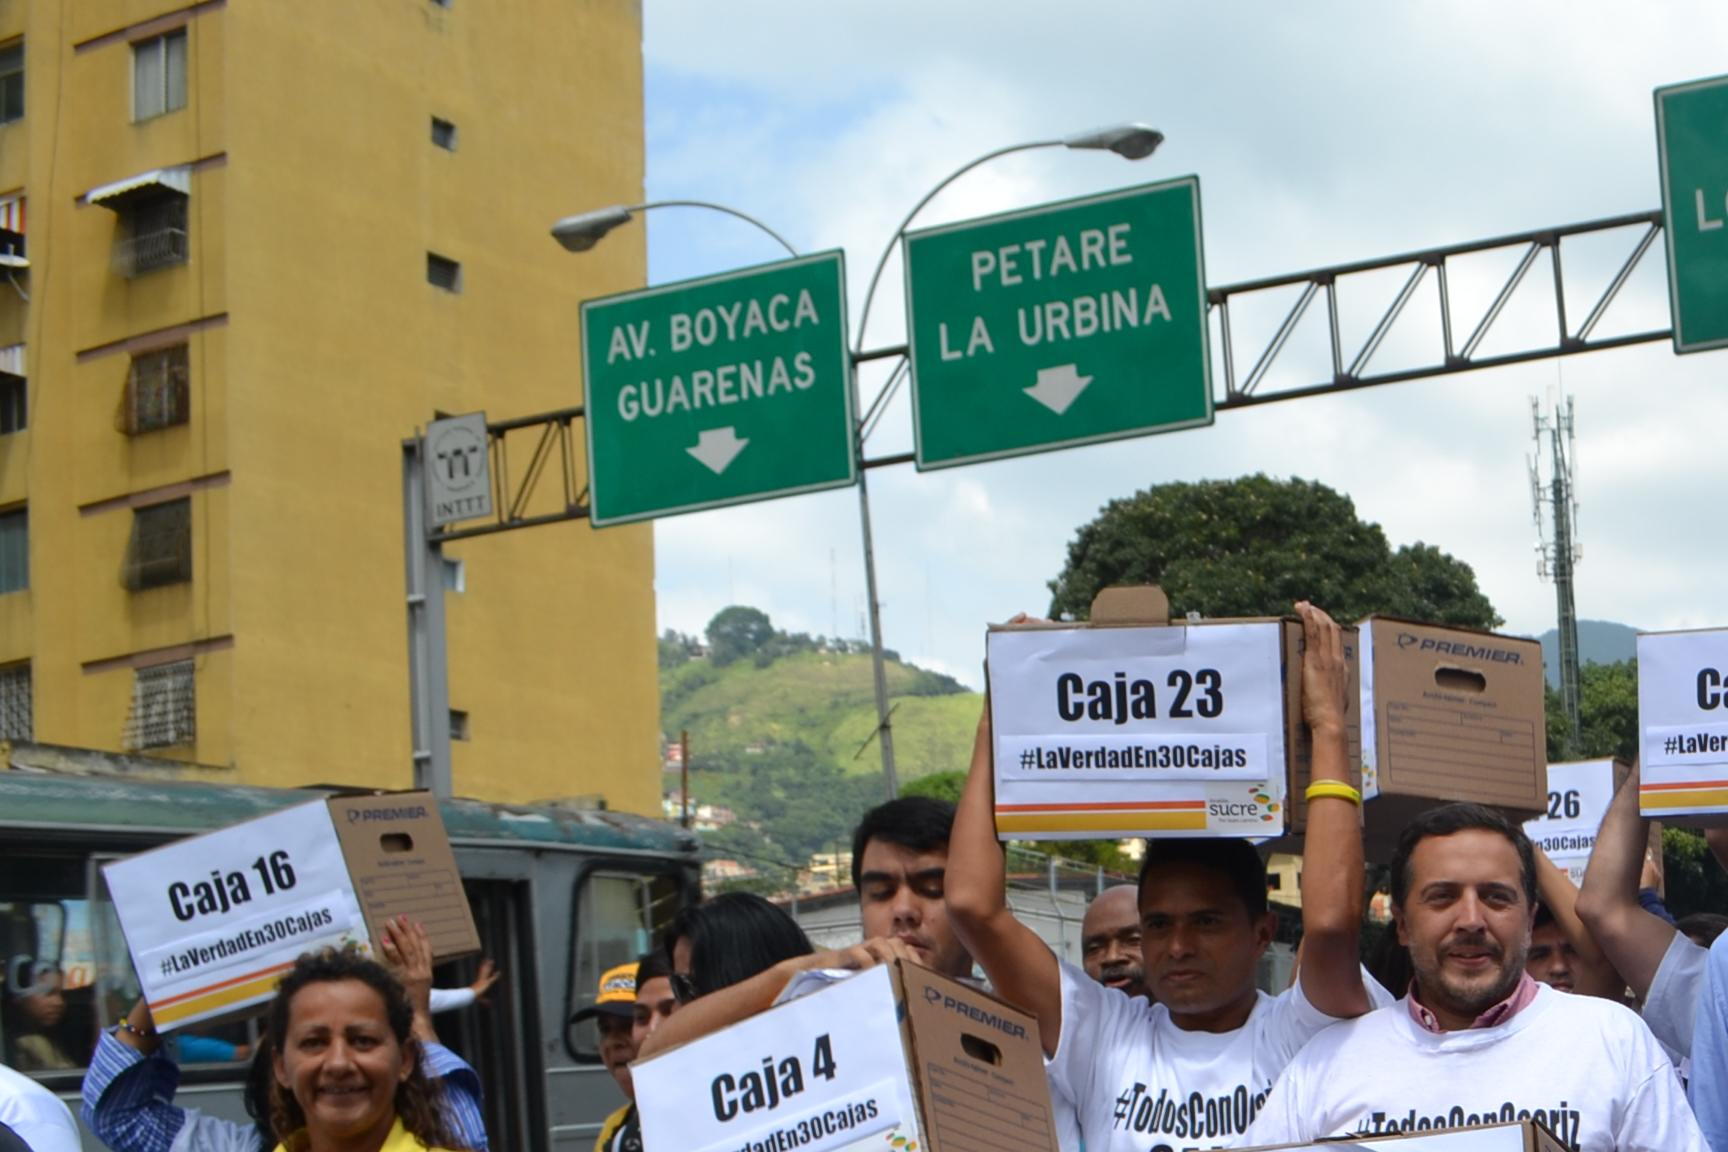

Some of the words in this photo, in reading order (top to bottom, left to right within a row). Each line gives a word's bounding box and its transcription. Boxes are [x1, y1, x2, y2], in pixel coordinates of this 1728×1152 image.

[970, 222, 1133, 292] PETARE
[606, 322, 656, 364] AV.
[669, 289, 820, 353] BOYACA
[938, 315, 995, 362] LA
[1017, 283, 1172, 347] URBINA
[616, 351, 816, 422] GUARENAS
[436, 494, 486, 517] INTTT
[1420, 637, 1522, 665] PREMIER
[1056, 671, 1157, 725] Caja
[1167, 668, 1224, 719] 23
[1020, 744, 1247, 771] #LaVerdadEn30Cajas
[362, 806, 427, 822] PREMIER
[1209, 802, 1258, 817] sucre
[1547, 789, 1581, 820] 26
[167, 869, 252, 924] Caja
[251, 848, 298, 897] 16
[160, 905, 333, 978] #LaVerdadEn30Cajas
[943, 995, 1027, 1041] PREMIER
[710, 1054, 804, 1124] Caja
[811, 1032, 837, 1082] 4
